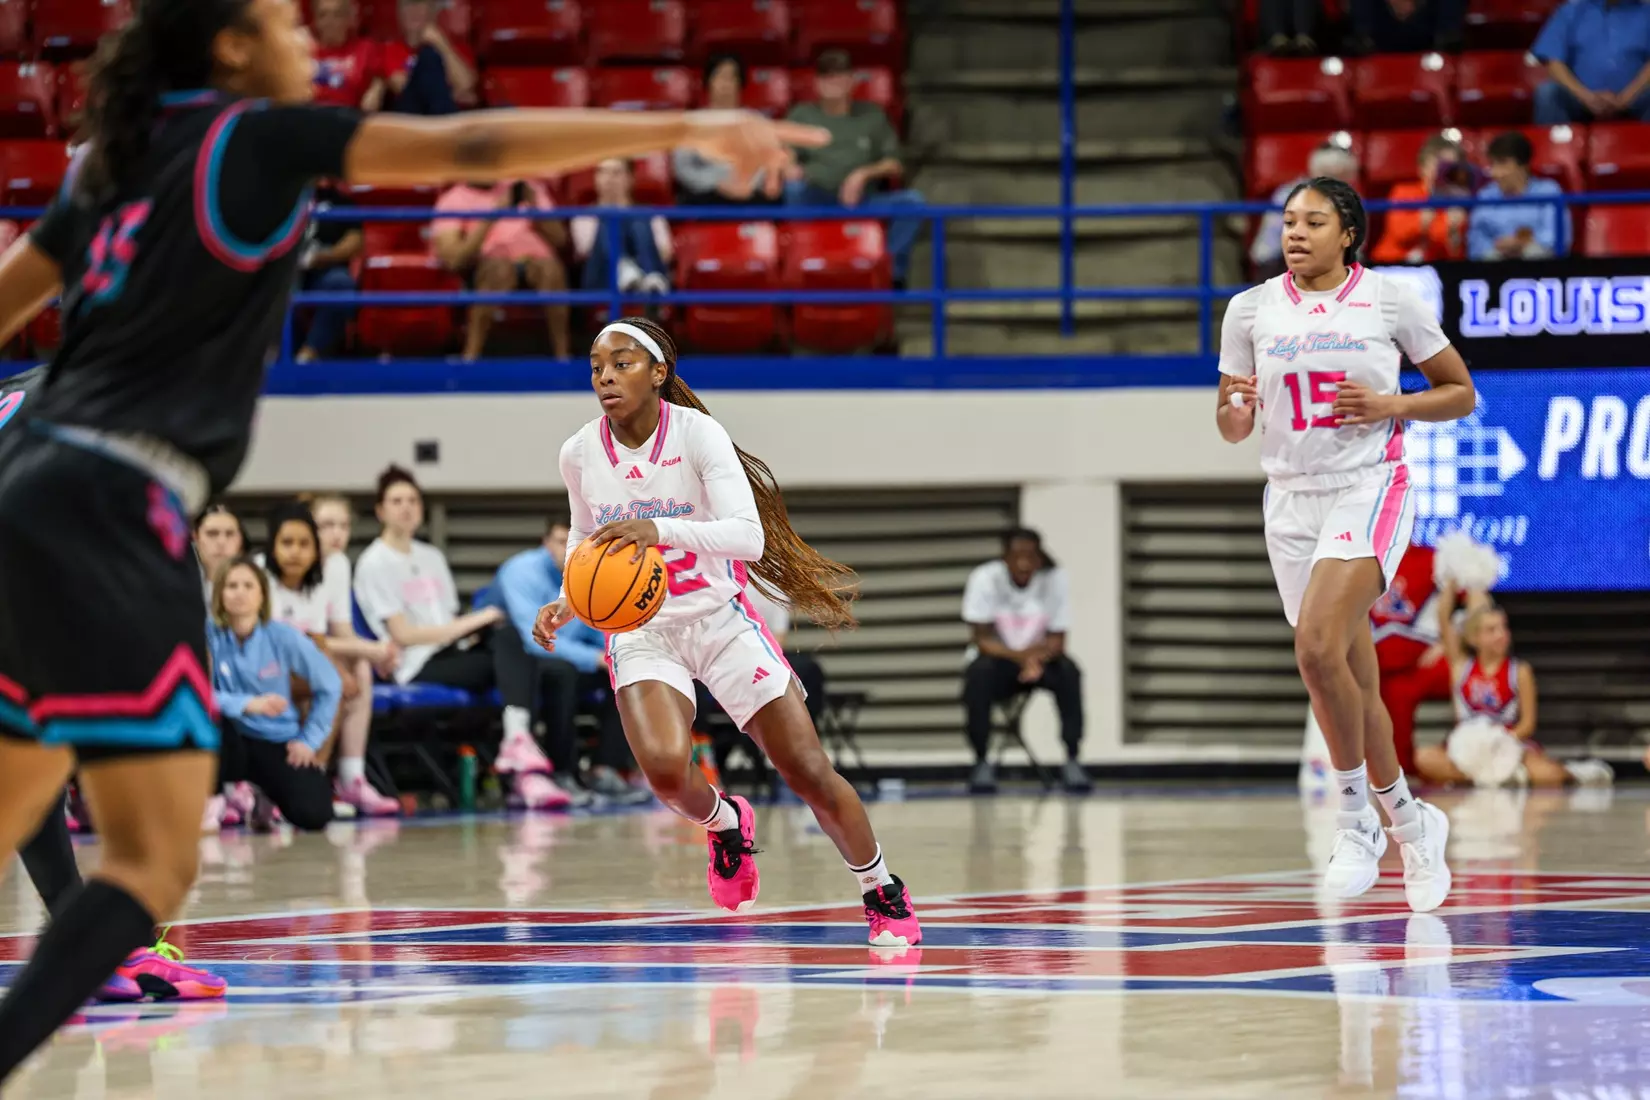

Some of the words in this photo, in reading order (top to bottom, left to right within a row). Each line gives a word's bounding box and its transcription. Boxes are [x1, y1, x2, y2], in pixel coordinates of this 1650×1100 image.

[1459, 277, 1650, 337] LOUIS
[1267, 335, 1304, 362] Lady
[1304, 330, 1368, 352] Techsters
[1283, 370, 1347, 432] 15
[628, 497, 695, 520] Techsters
[634, 561, 664, 611] NCAA
